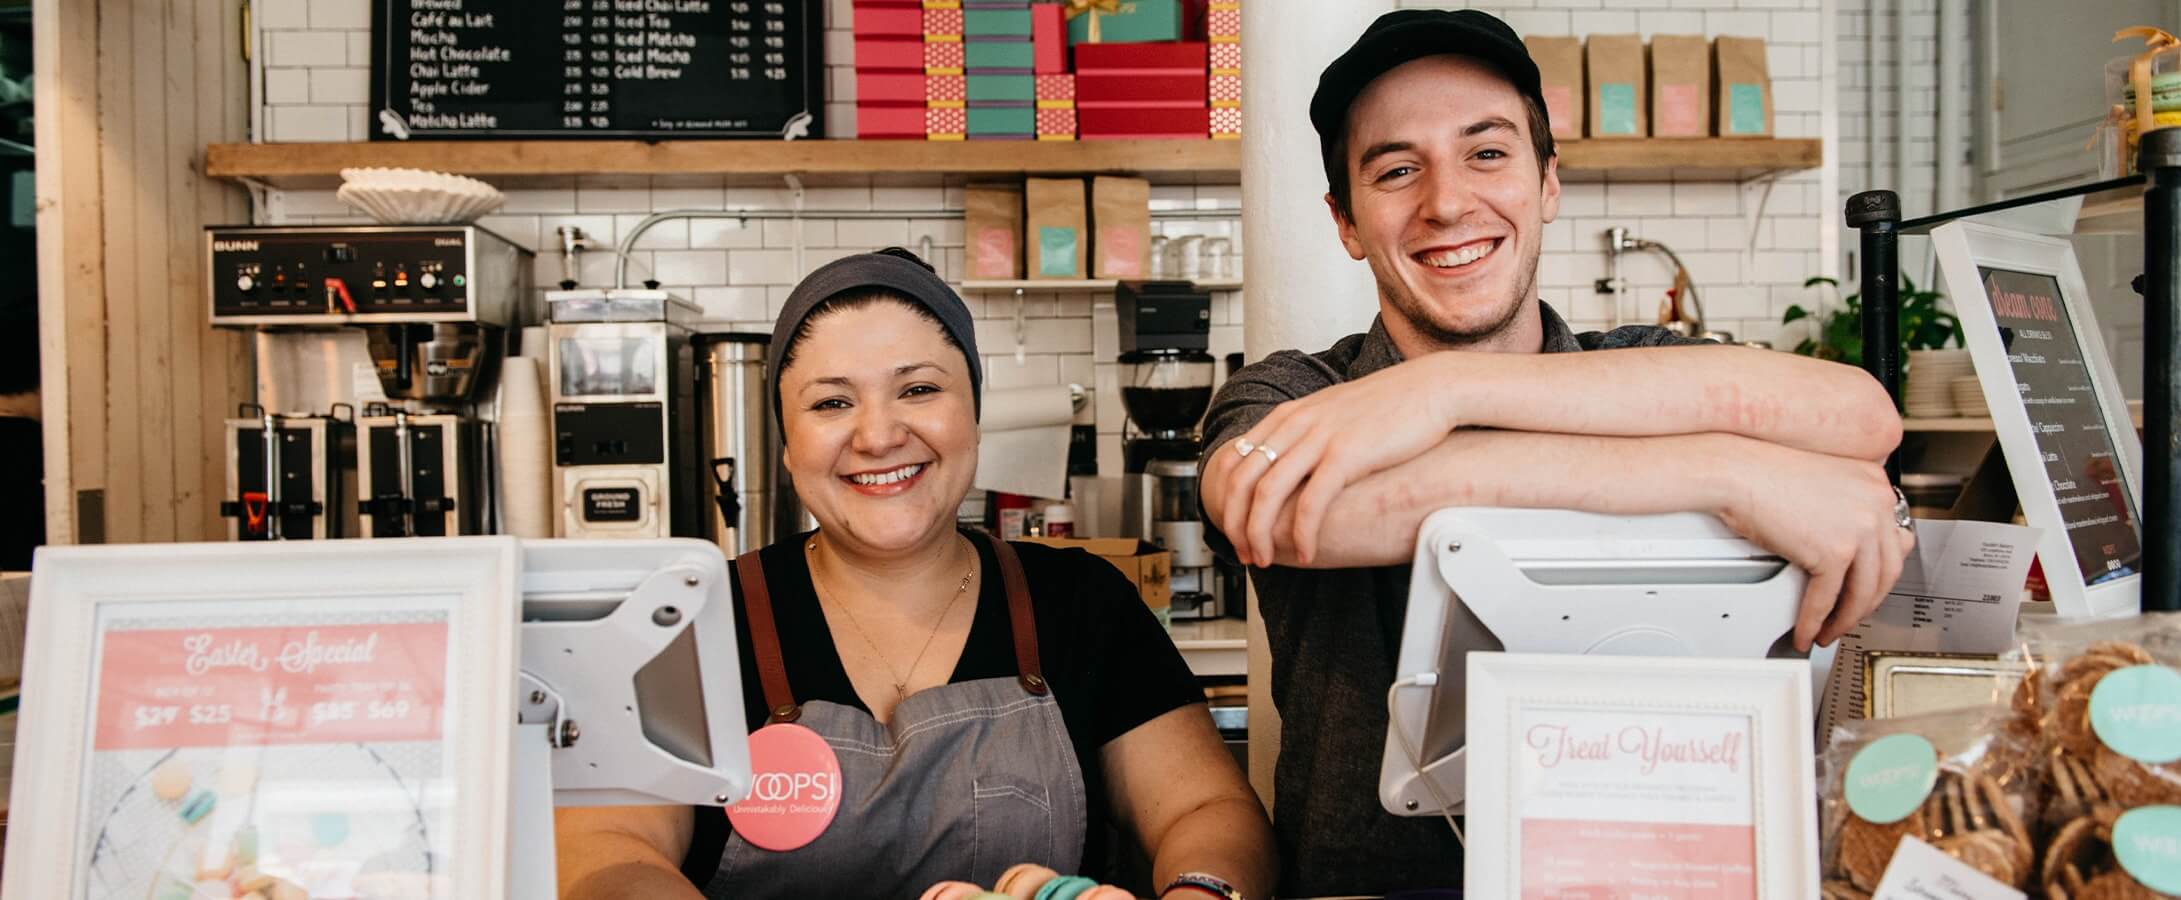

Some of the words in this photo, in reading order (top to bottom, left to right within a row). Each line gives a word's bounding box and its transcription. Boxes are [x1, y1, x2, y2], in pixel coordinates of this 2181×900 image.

[615, 0, 643, 11] Iced
[645, 0, 673, 12] Chai
[675, 0, 709, 12] Latte
[411, 11, 445, 27] Café
[448, 16, 463, 27] au
[466, 13, 492, 27] Lait
[615, 15, 644, 28] Iced
[648, 14, 670, 28] Tea
[411, 29, 457, 45] Mocha
[615, 31, 644, 46] Iced
[648, 32, 696, 47] Matcha
[410, 47, 436, 61] Hot
[440, 46, 510, 61] Chocolate
[615, 48, 644, 63] Iced
[647, 48, 691, 65] Mocha
[410, 63, 439, 78] Chai
[443, 63, 479, 78] Latte
[614, 65, 643, 79] Cold
[646, 64, 681, 79] Brew
[411, 81, 448, 98] Apple
[451, 80, 488, 94] Cider
[411, 98, 434, 113] Tea
[409, 114, 458, 127] Matcha
[460, 113, 496, 127] Latte
[214, 240, 259, 252] BUNN
[434, 238, 463, 247] DUAL
[184, 633, 268, 675] Easter
[275, 630, 379, 673] Special
[189, 704, 232, 725] $25
[367, 699, 411, 720] $69
[1526, 723, 1612, 768] Treat
[1617, 726, 1743, 776] Yourself
